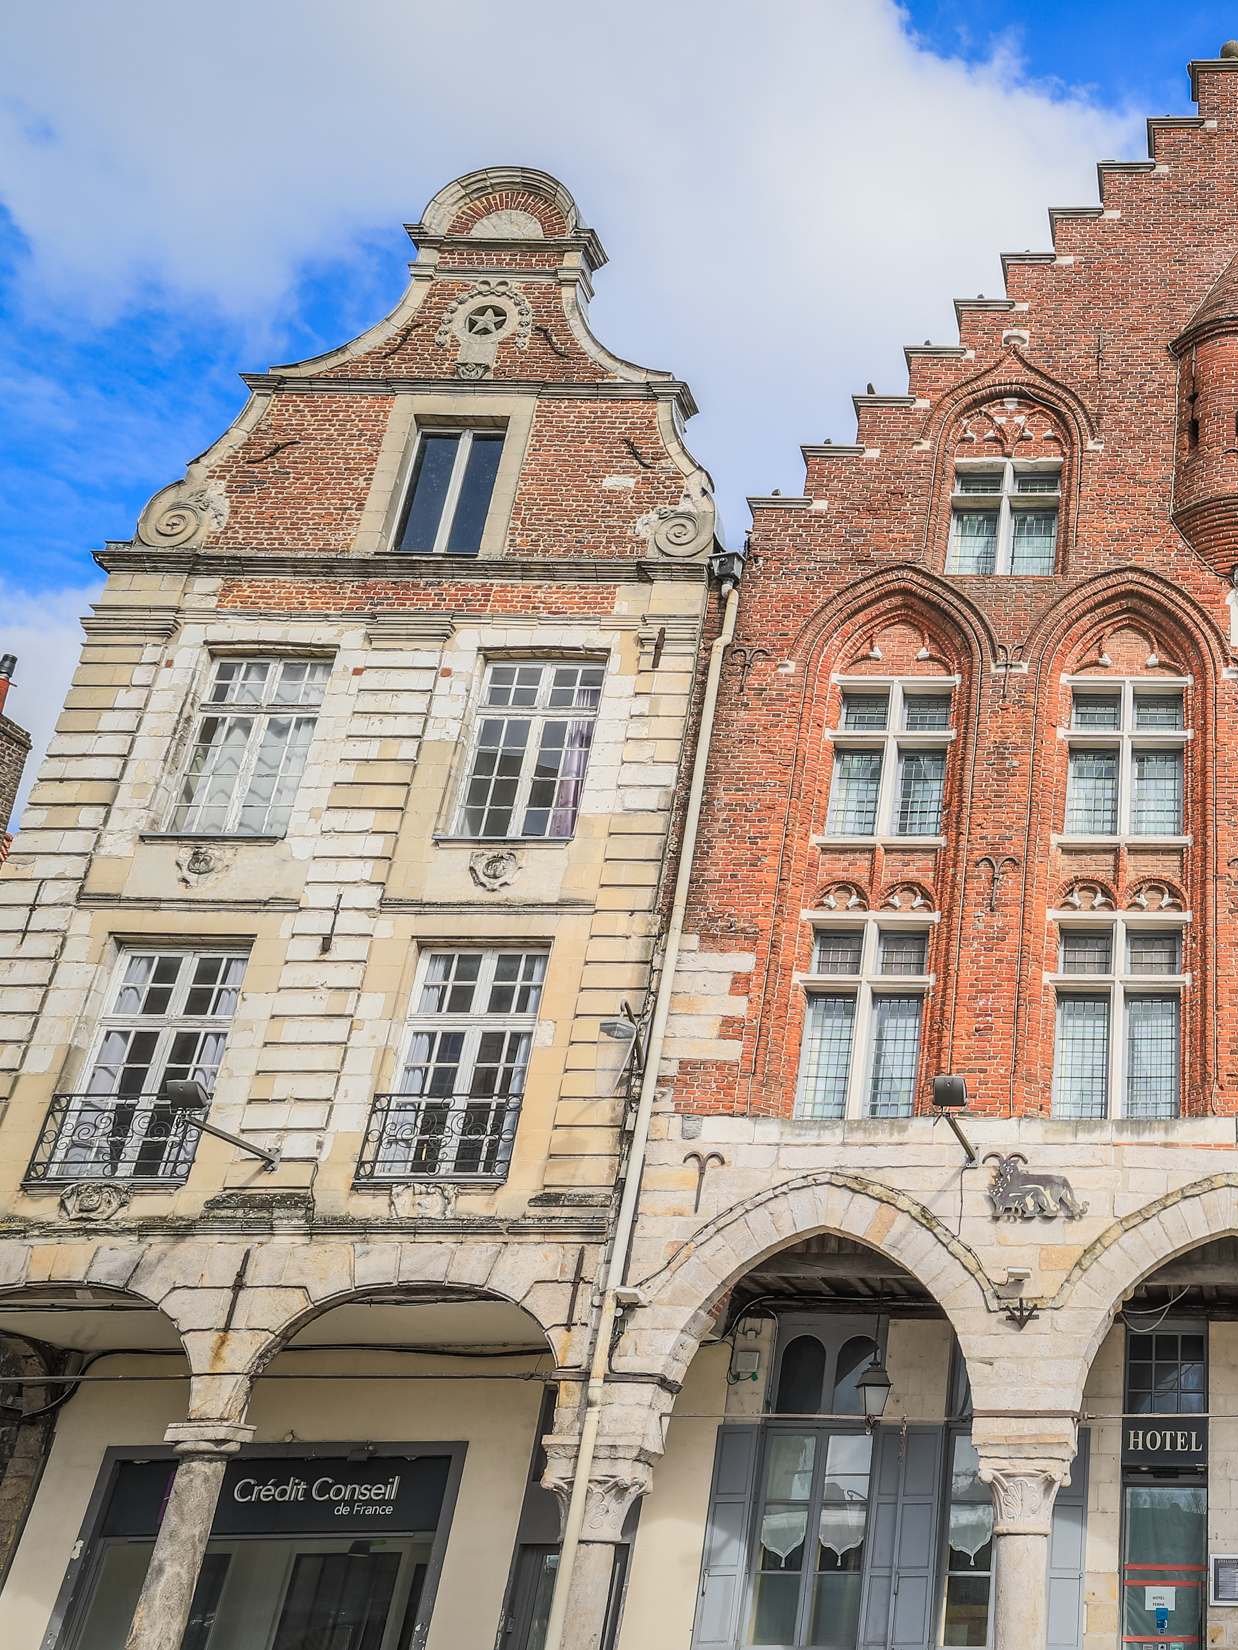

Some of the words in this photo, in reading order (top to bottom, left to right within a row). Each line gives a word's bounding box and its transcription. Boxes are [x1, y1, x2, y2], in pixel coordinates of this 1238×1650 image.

[1127, 1430, 1203, 1452] HOTEL
[233, 1476, 308, 1502] Crédit
[311, 1475, 401, 1501] Conseil
[334, 1502, 350, 1515] de
[353, 1502, 394, 1515] France
